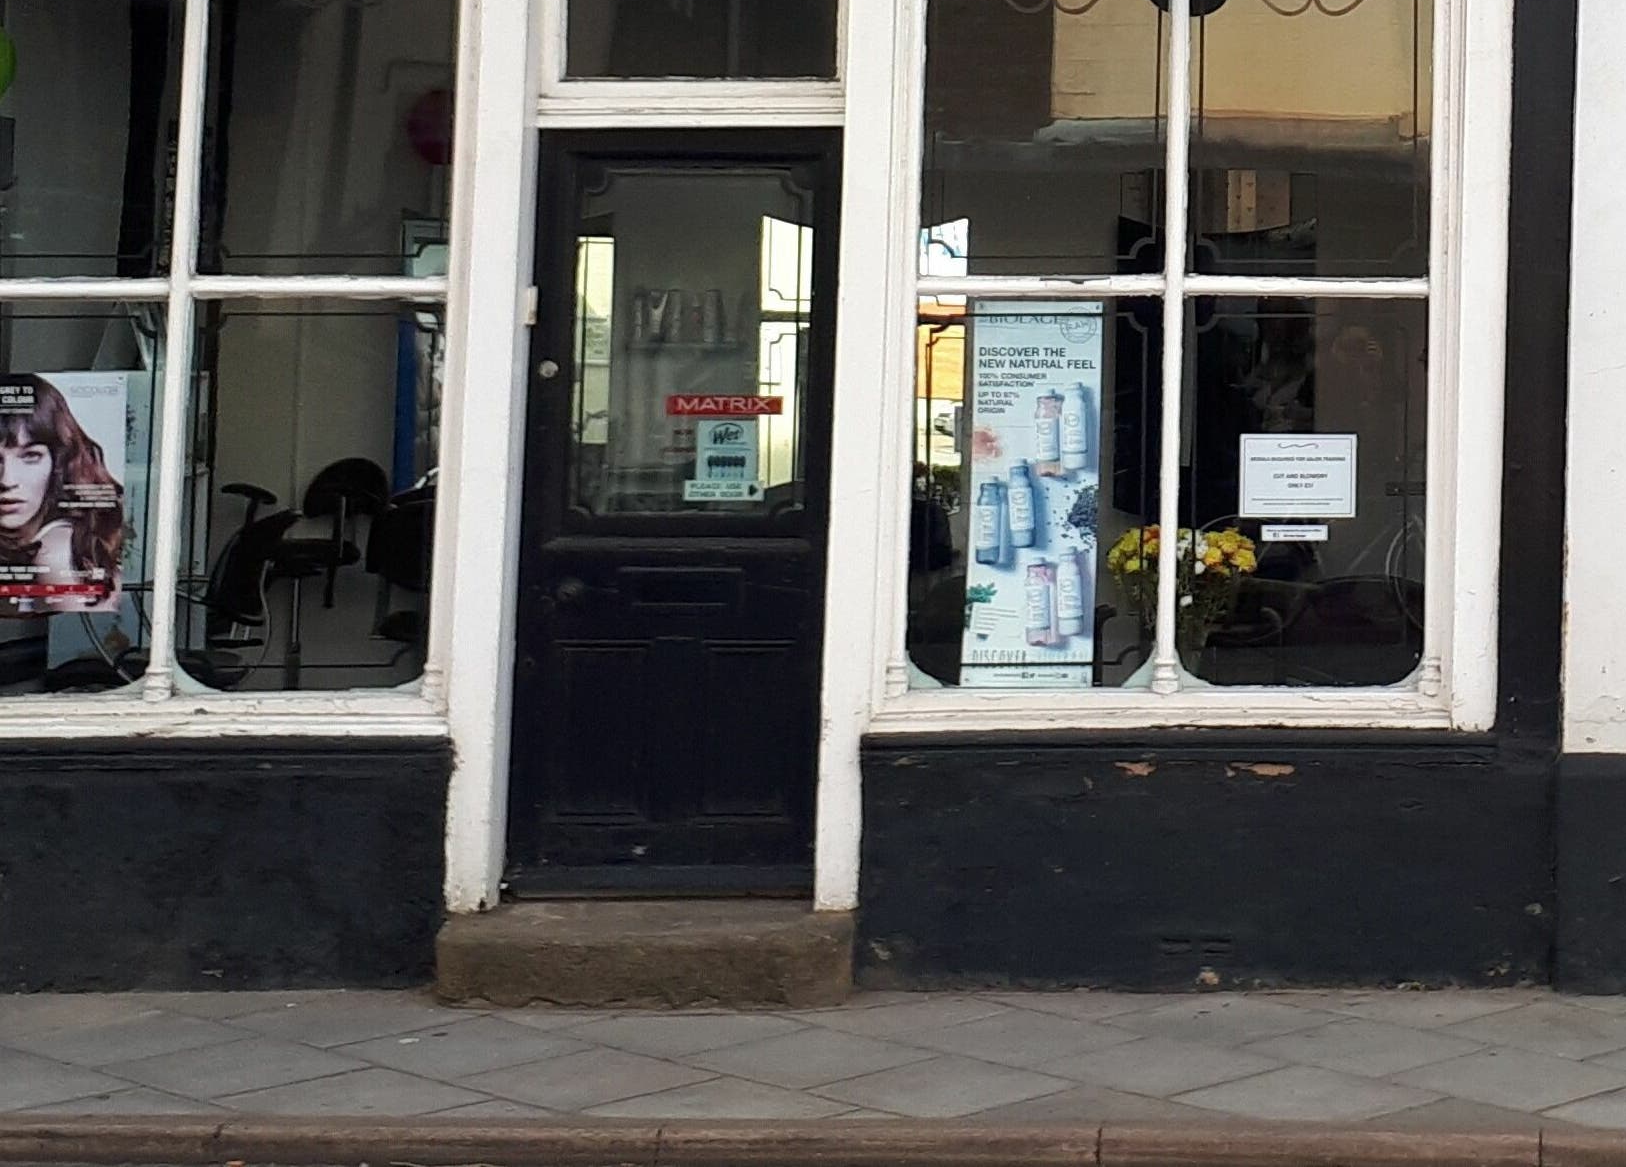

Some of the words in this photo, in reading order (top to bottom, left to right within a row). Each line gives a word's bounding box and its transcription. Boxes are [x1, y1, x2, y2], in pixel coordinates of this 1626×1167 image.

[978, 346, 1040, 357] DISCOVER
[1043, 347, 1066, 357] THE
[978, 359, 1005, 369] NEW
[1009, 359, 1063, 369] NATURAL
[1067, 359, 1096, 369] FEEL
[676, 397, 769, 410] MATRIX
